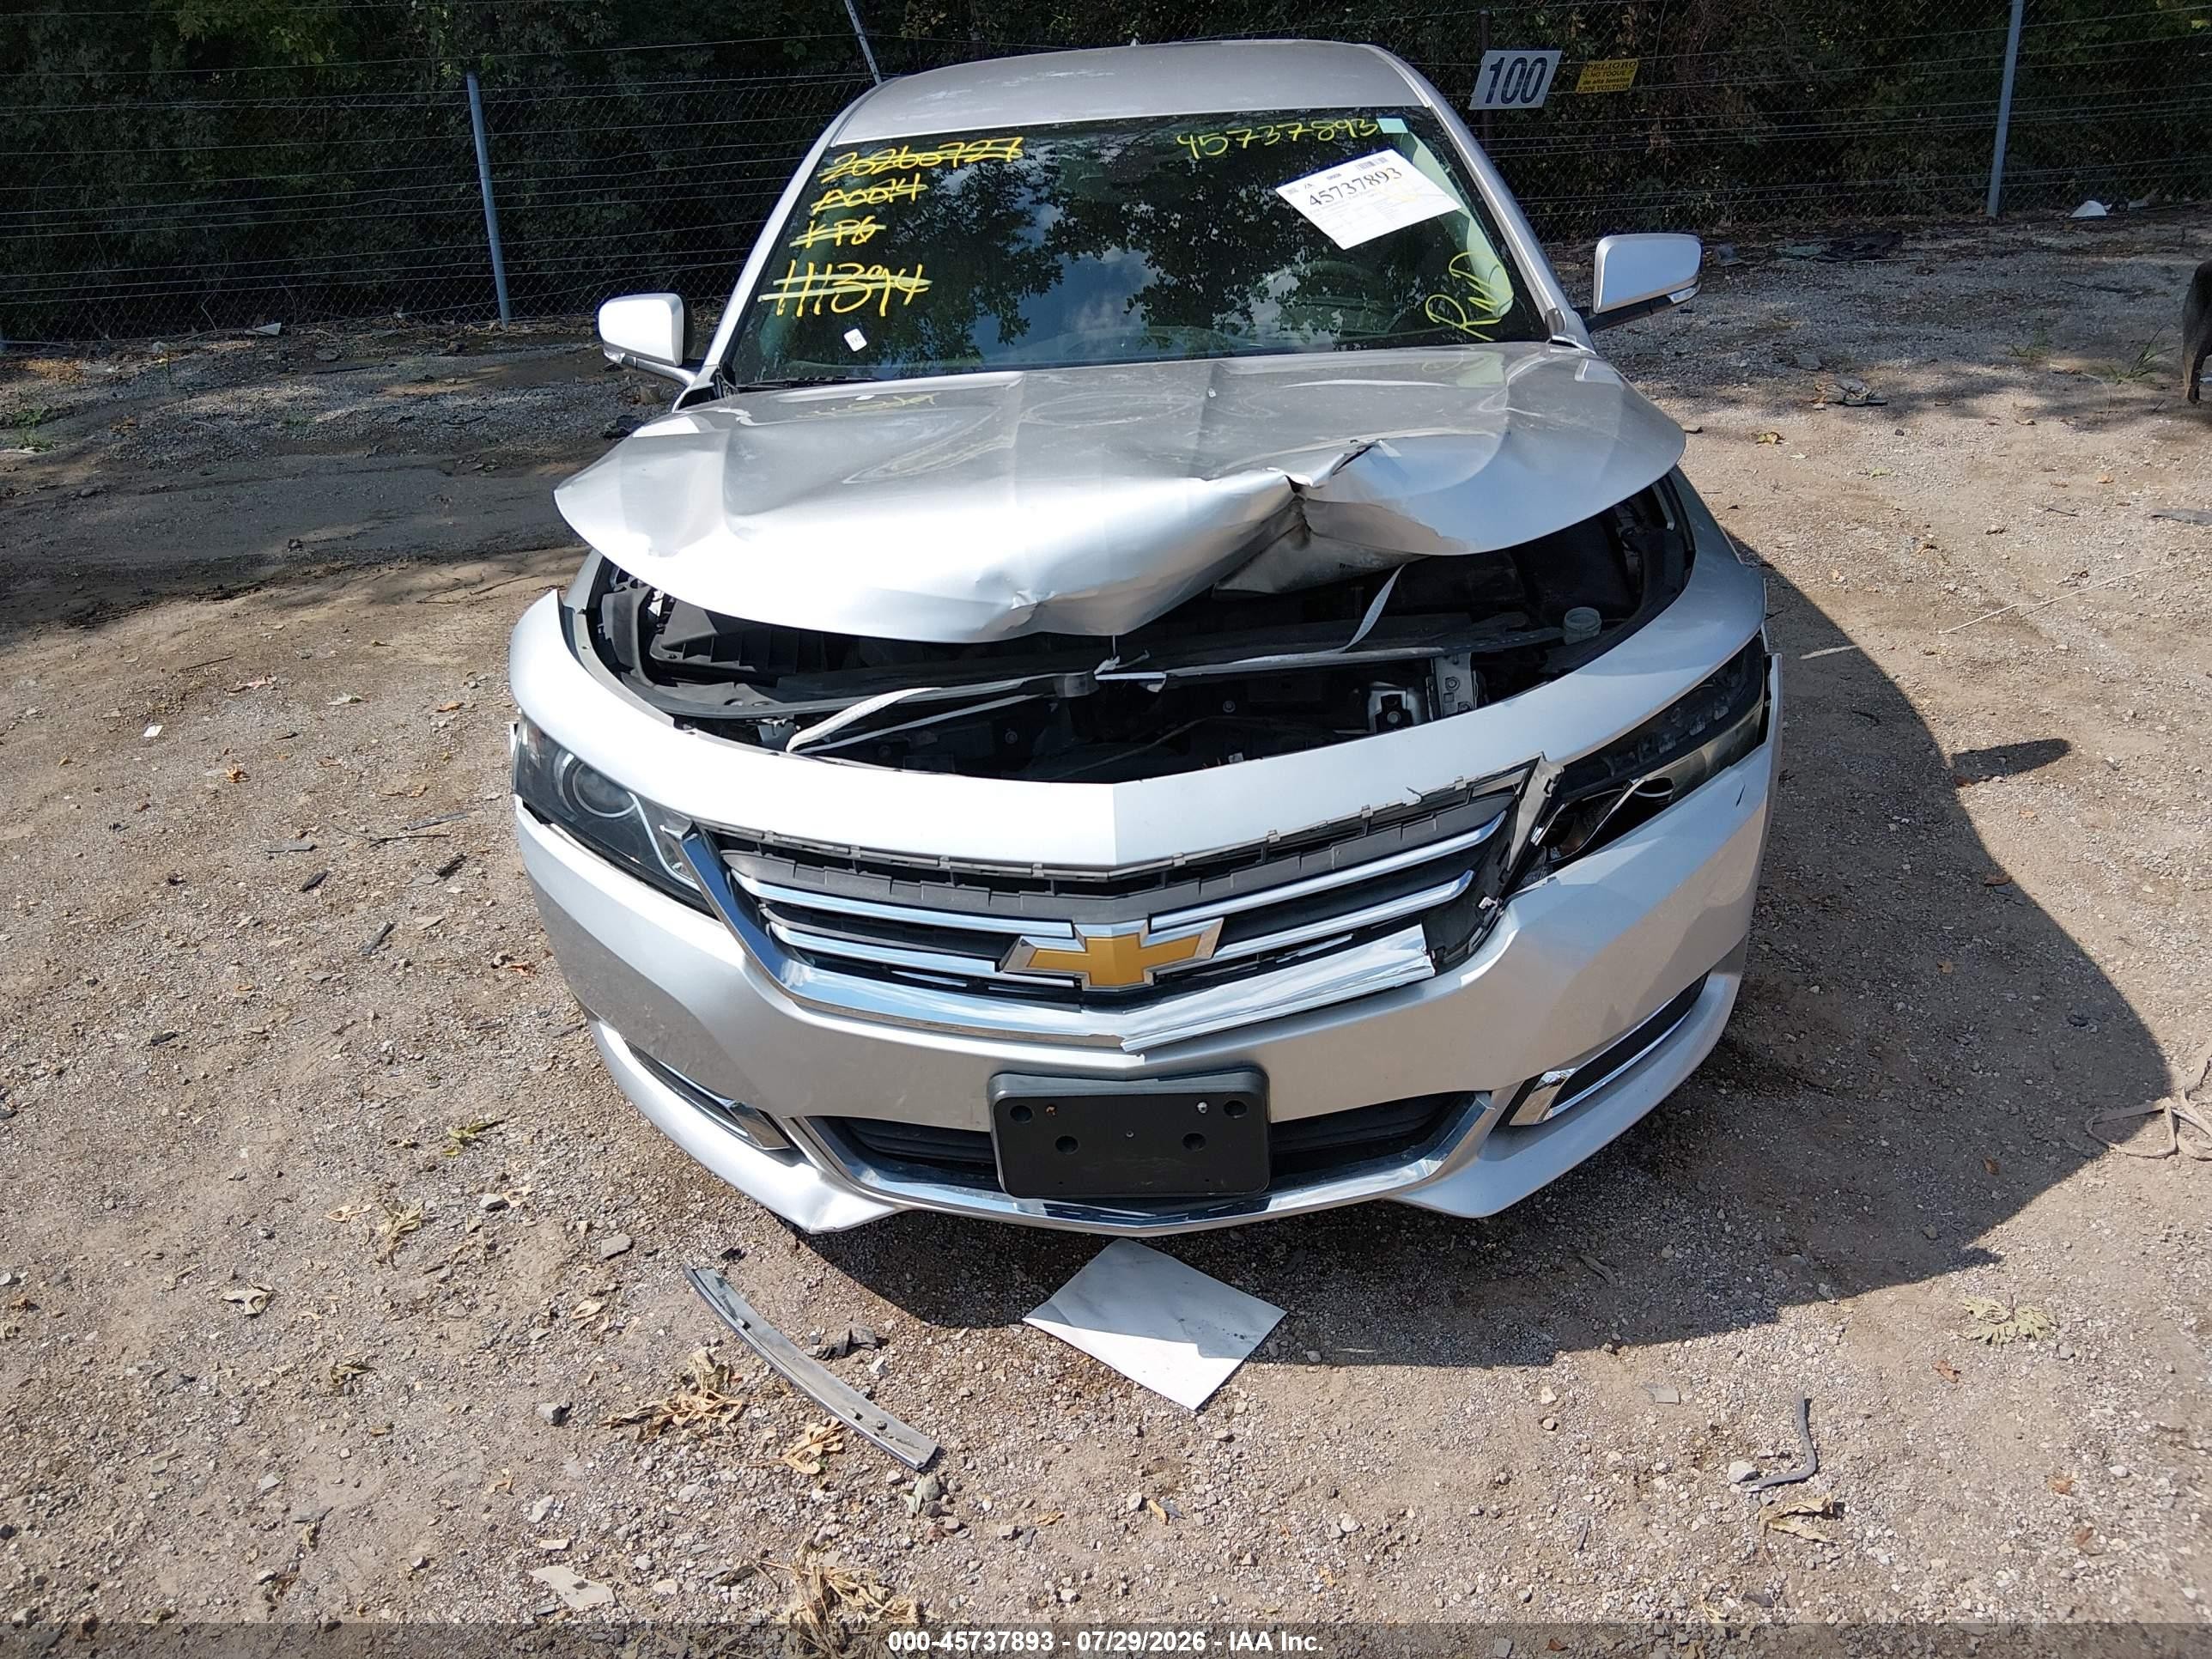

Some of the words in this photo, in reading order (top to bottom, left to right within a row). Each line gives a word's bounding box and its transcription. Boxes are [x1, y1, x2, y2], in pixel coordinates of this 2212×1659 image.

[1485, 57, 1548, 104] 100
[818, 137, 1024, 184] 20260727
[1177, 118, 1379, 160] 45737893
[1310, 167, 1402, 206] 45737893
